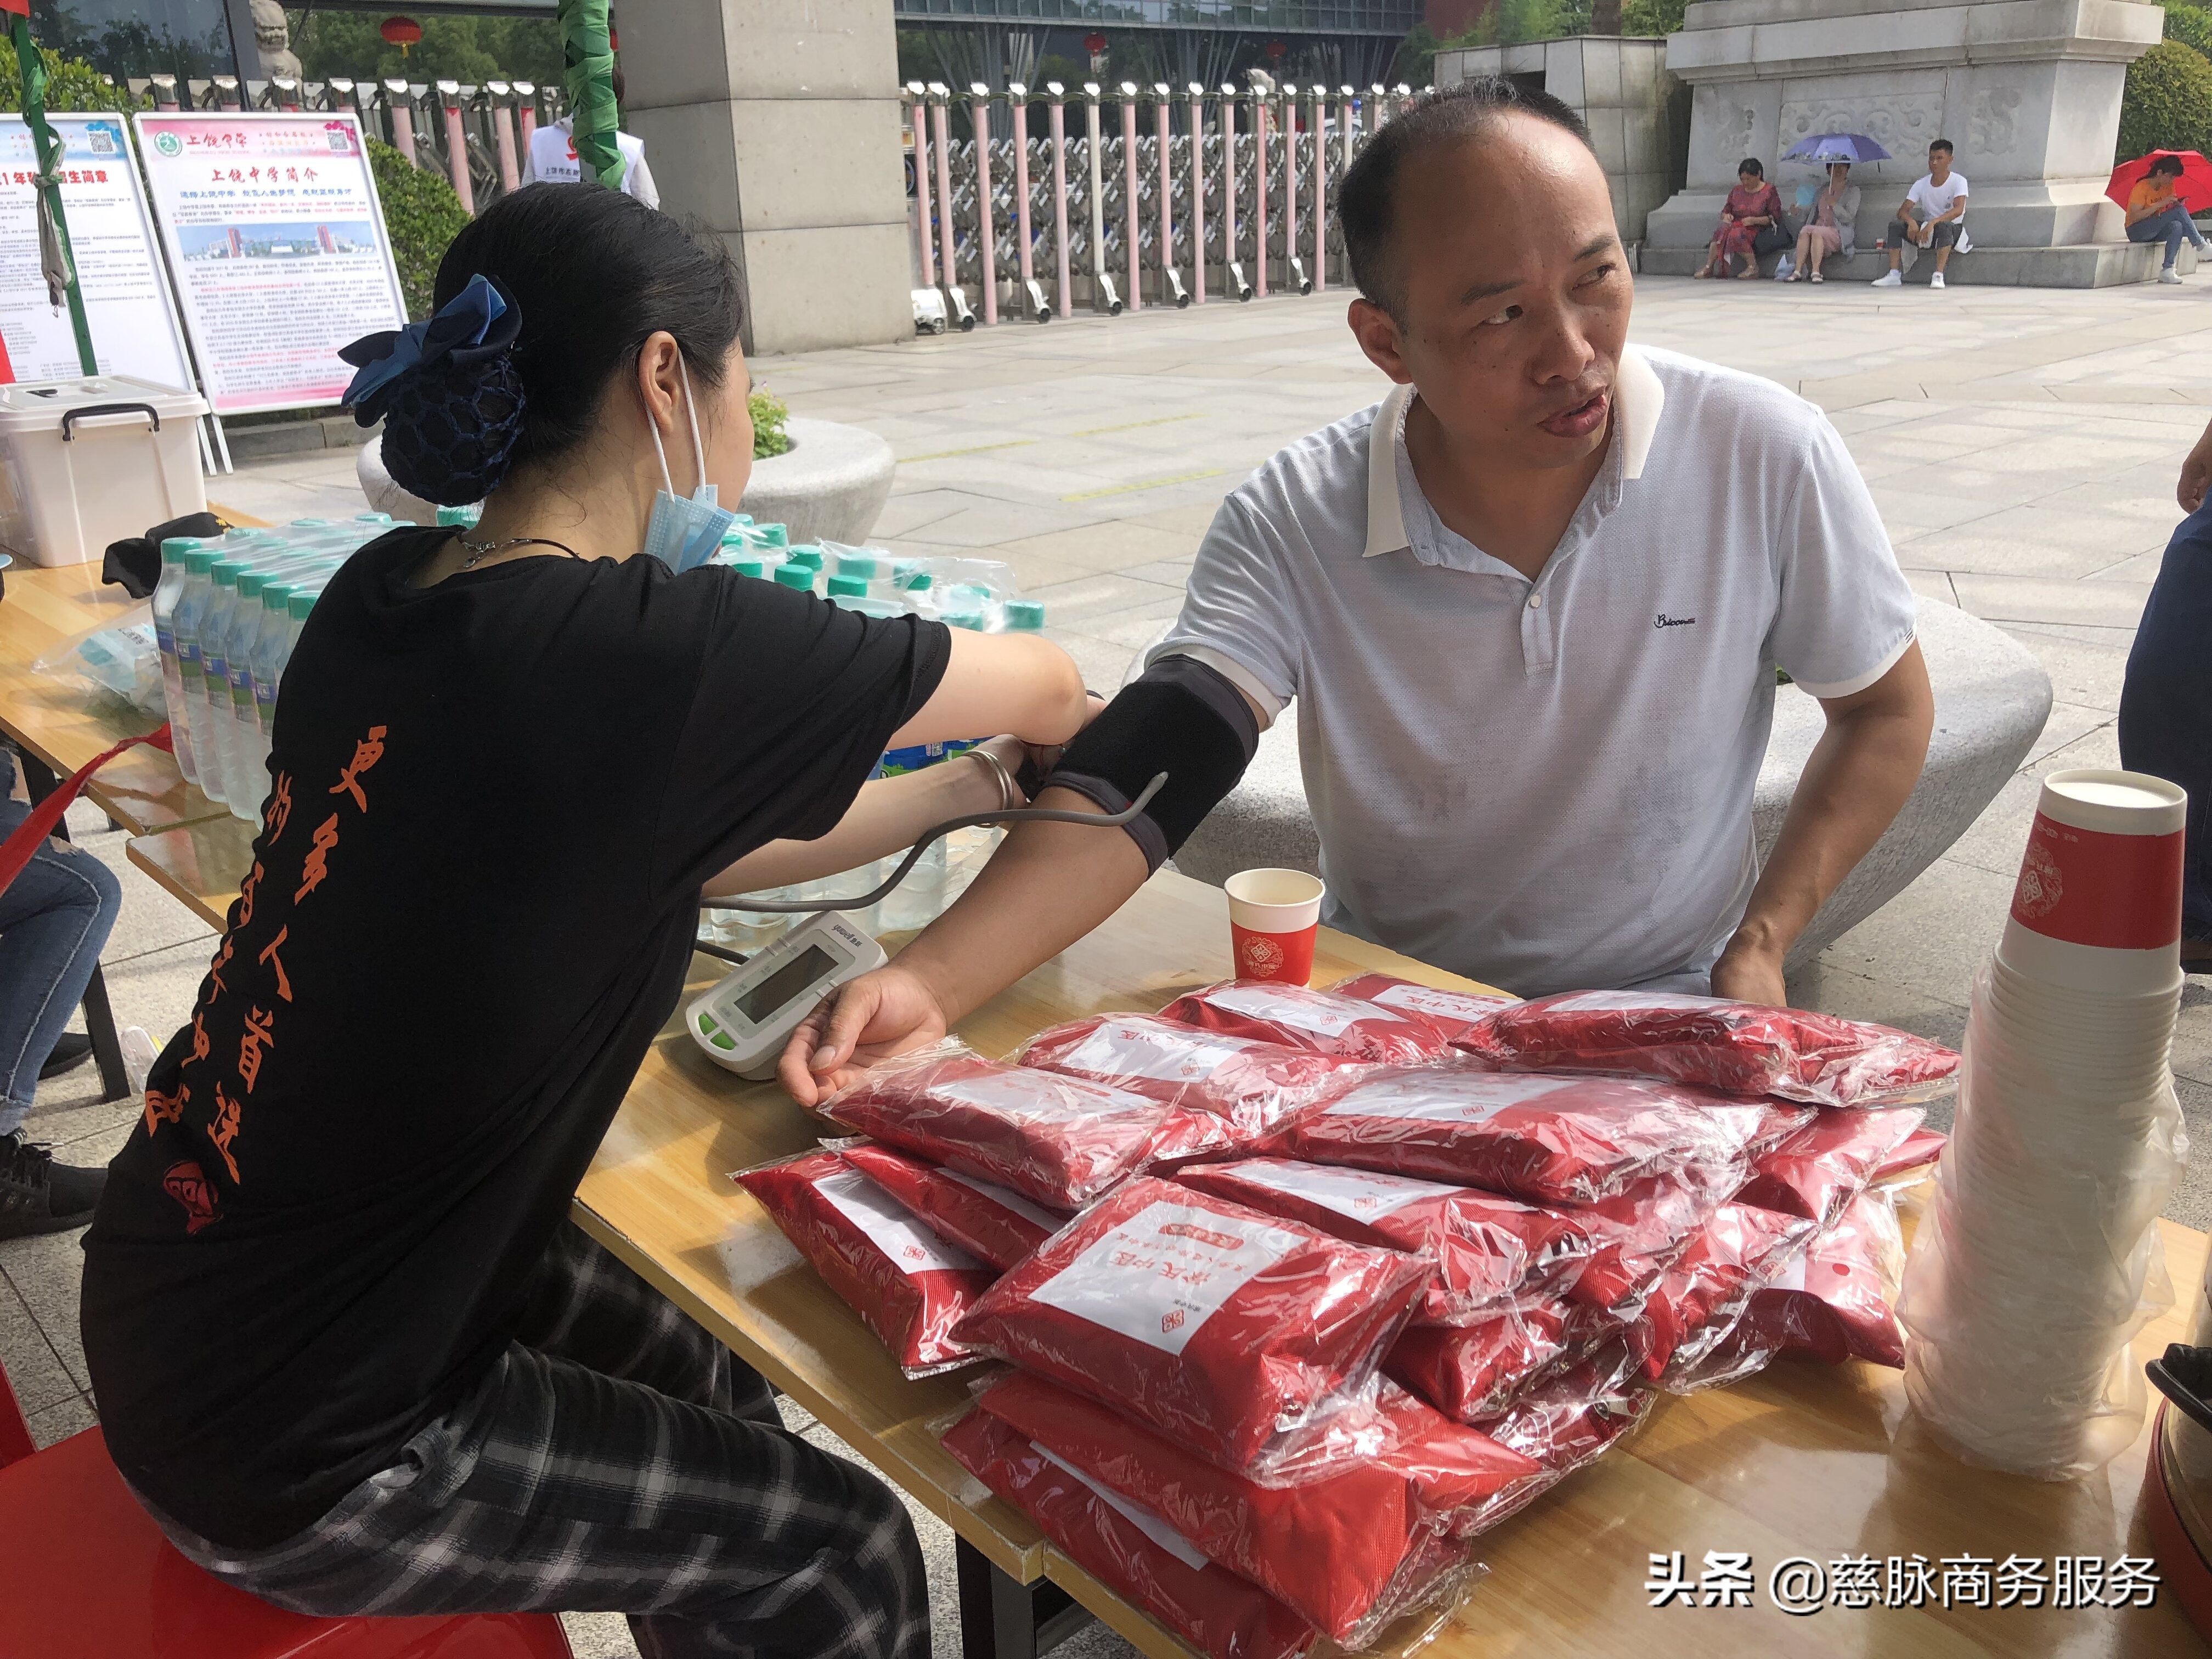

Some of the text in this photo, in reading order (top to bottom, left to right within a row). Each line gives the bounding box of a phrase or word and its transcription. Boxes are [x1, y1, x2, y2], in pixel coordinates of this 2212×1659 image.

[212, 167, 318, 183] 上饶中学简介
[831, 924, 855, 940] yuwell
